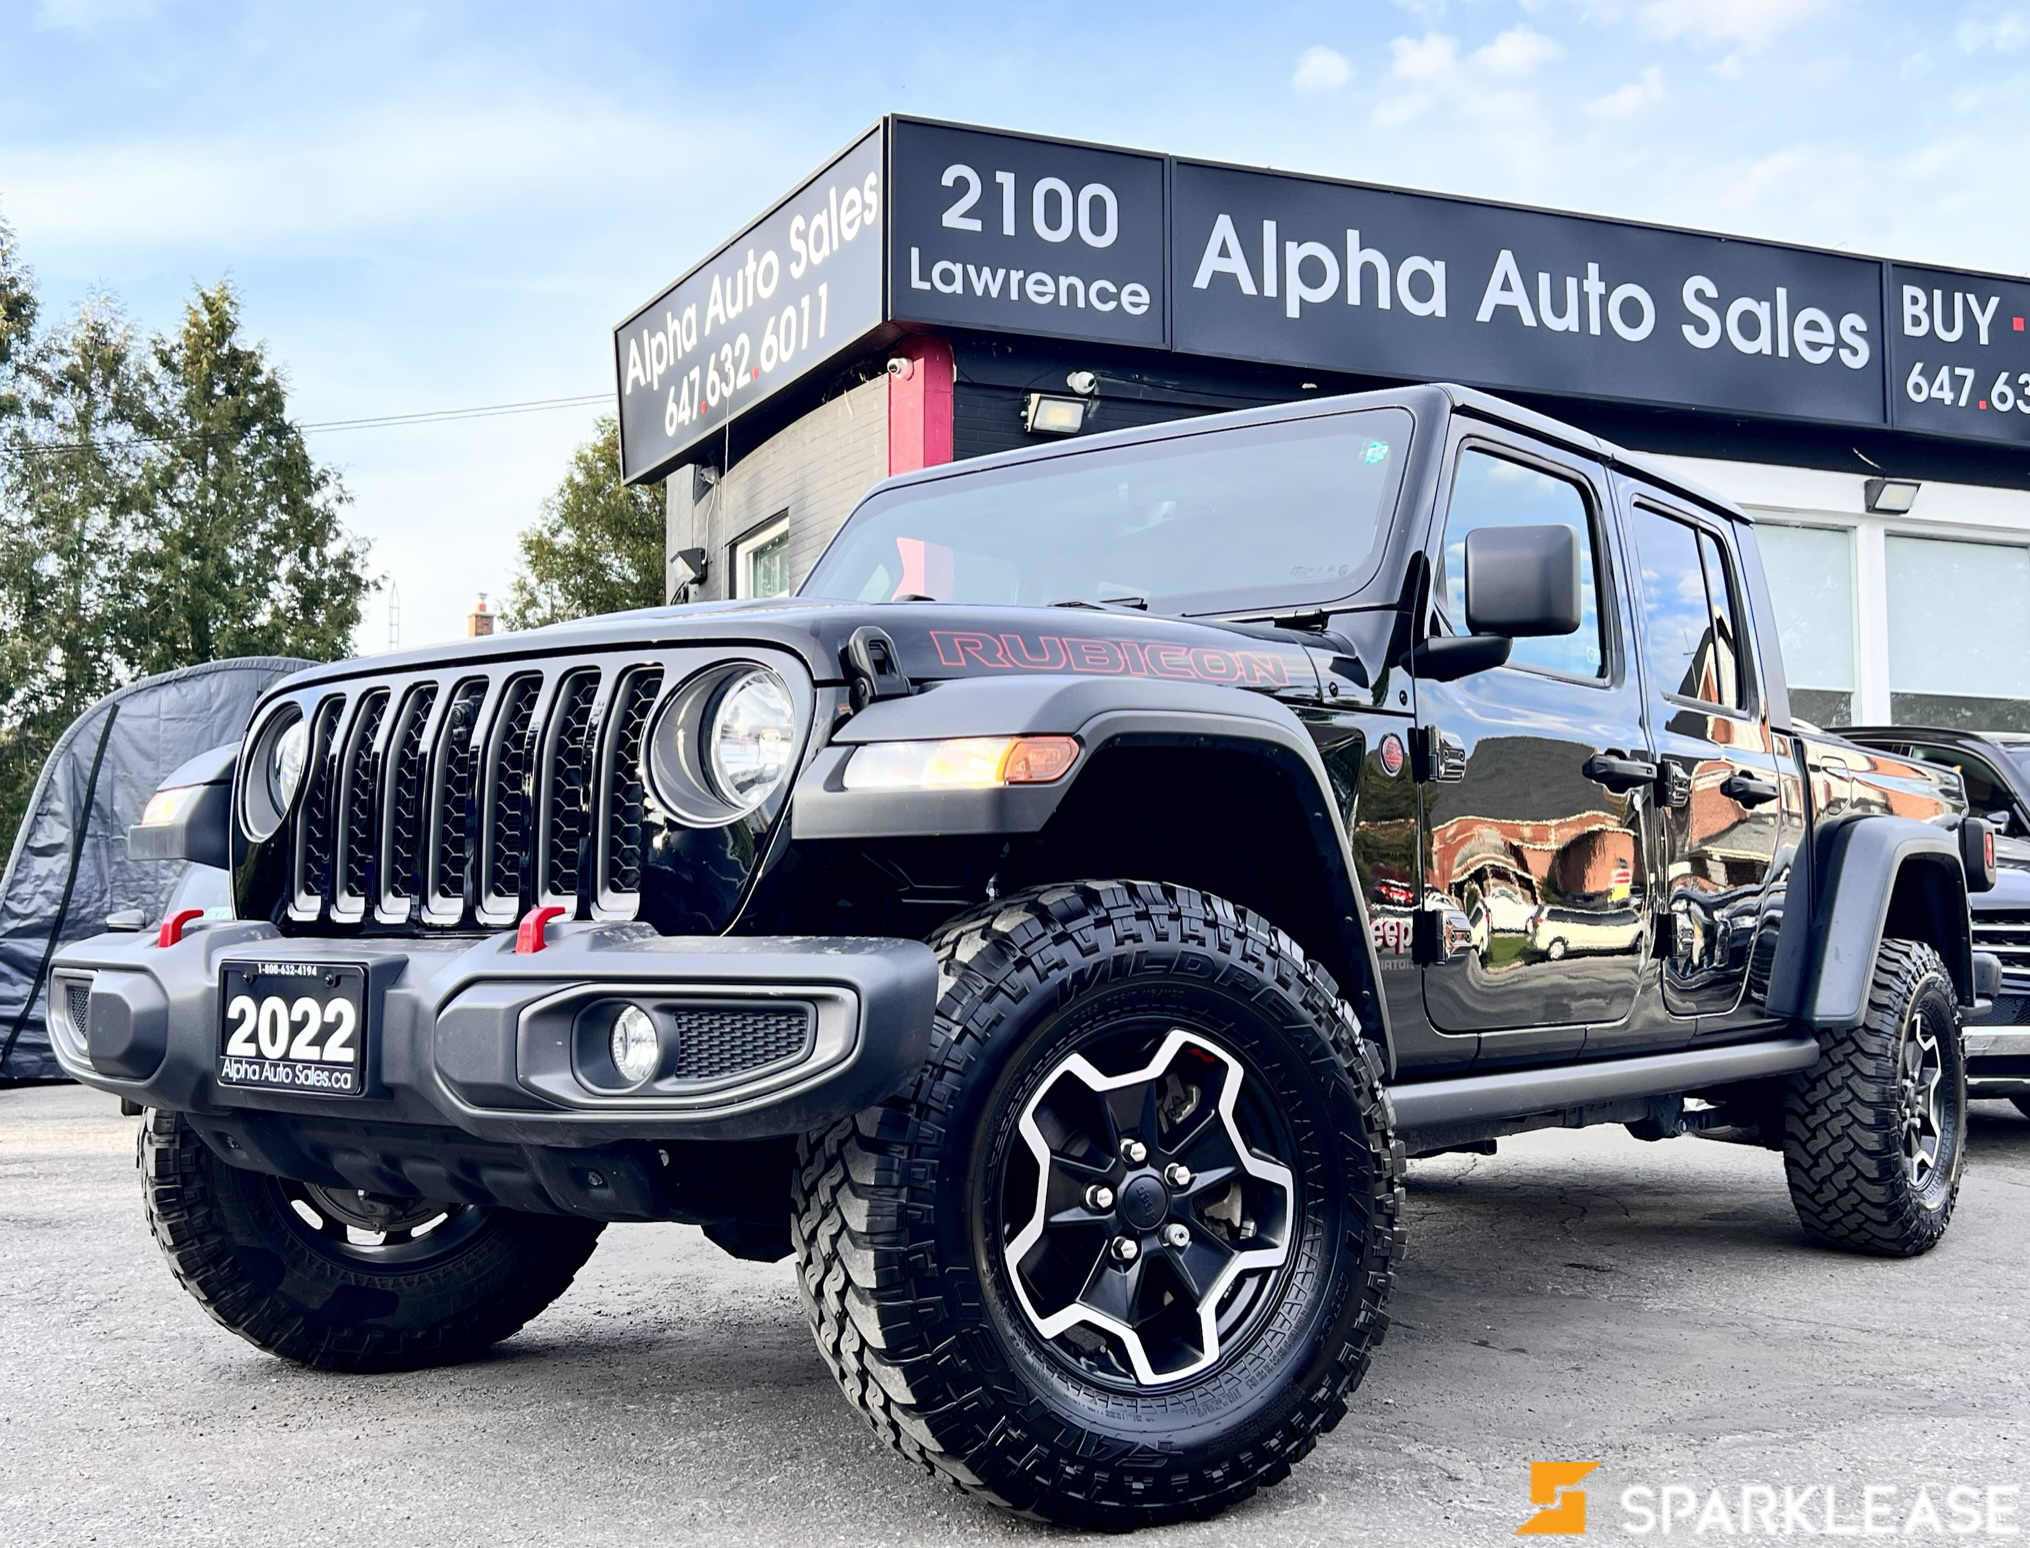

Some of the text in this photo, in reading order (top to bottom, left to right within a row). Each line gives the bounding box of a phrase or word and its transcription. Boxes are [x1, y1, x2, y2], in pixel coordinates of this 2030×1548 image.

[941, 164, 1119, 249] 2100
[626, 171, 878, 395] Alpha Auto Sales
[910, 246, 1151, 316] Lawrence
[1193, 213, 1870, 369] Alpha Auto Sales
[1902, 284, 2001, 345] BUY
[665, 282, 829, 437] 647.632.6011
[928, 630, 1289, 686] RUBICON
[1369, 917, 1413, 954] eep
[226, 995, 357, 1062] 2022
[221, 1057, 352, 1089] Alpha Auto Sales.ca
